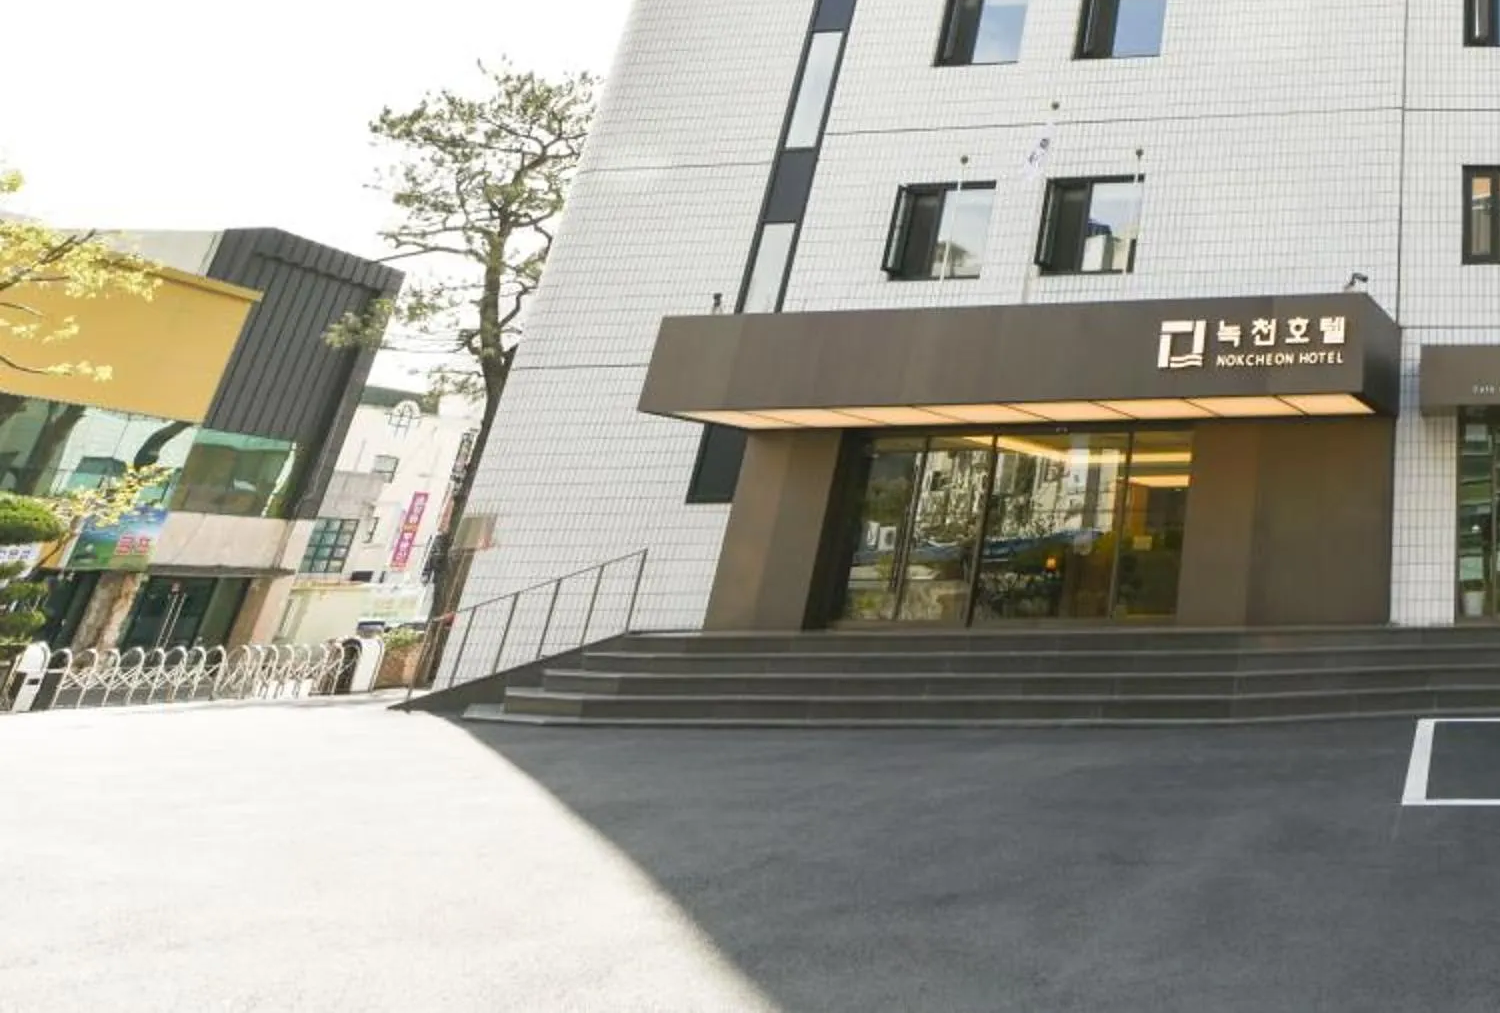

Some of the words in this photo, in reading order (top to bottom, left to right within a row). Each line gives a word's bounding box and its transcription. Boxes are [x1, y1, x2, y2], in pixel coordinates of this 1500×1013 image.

[1216, 316, 1345, 348] 녹천호텔
[1216, 352, 1295, 366] NOKCHEON
[1299, 350, 1344, 364] HOTEL
